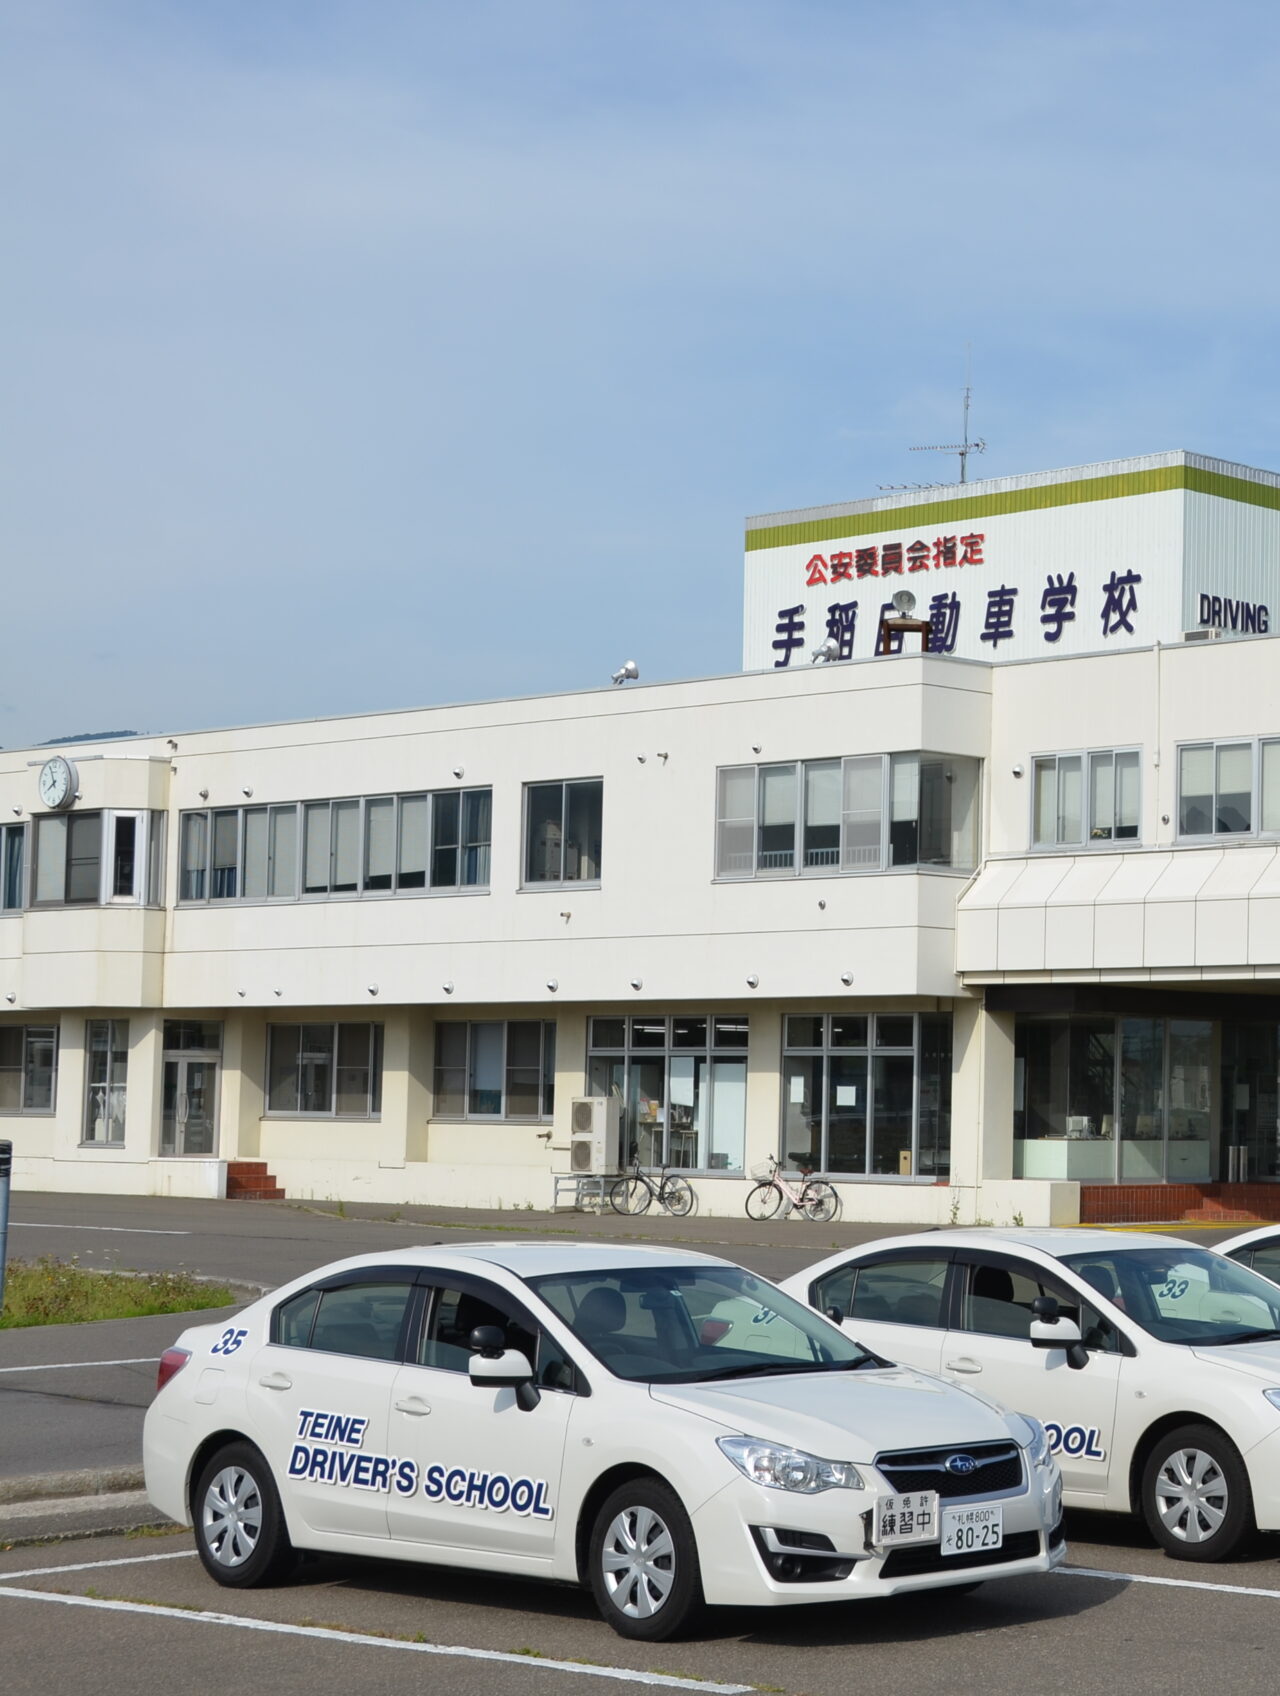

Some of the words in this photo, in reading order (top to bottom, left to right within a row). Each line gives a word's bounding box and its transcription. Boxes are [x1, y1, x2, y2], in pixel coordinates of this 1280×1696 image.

[806, 533, 985, 587] 公安委員会指定
[771, 569, 1142, 668] 手稲自動車学校
[1199, 593, 1269, 633] DRIVING
[1159, 1279, 1189, 1299] 33
[211, 1328, 248, 1355] 35
[298, 1410, 367, 1444] TEINE
[289, 1445, 416, 1493] DRIVER'S
[425, 1466, 551, 1516] SCHOOL
[881, 1510, 932, 1537] 練習中
[955, 1523, 1000, 1550] 80-25
